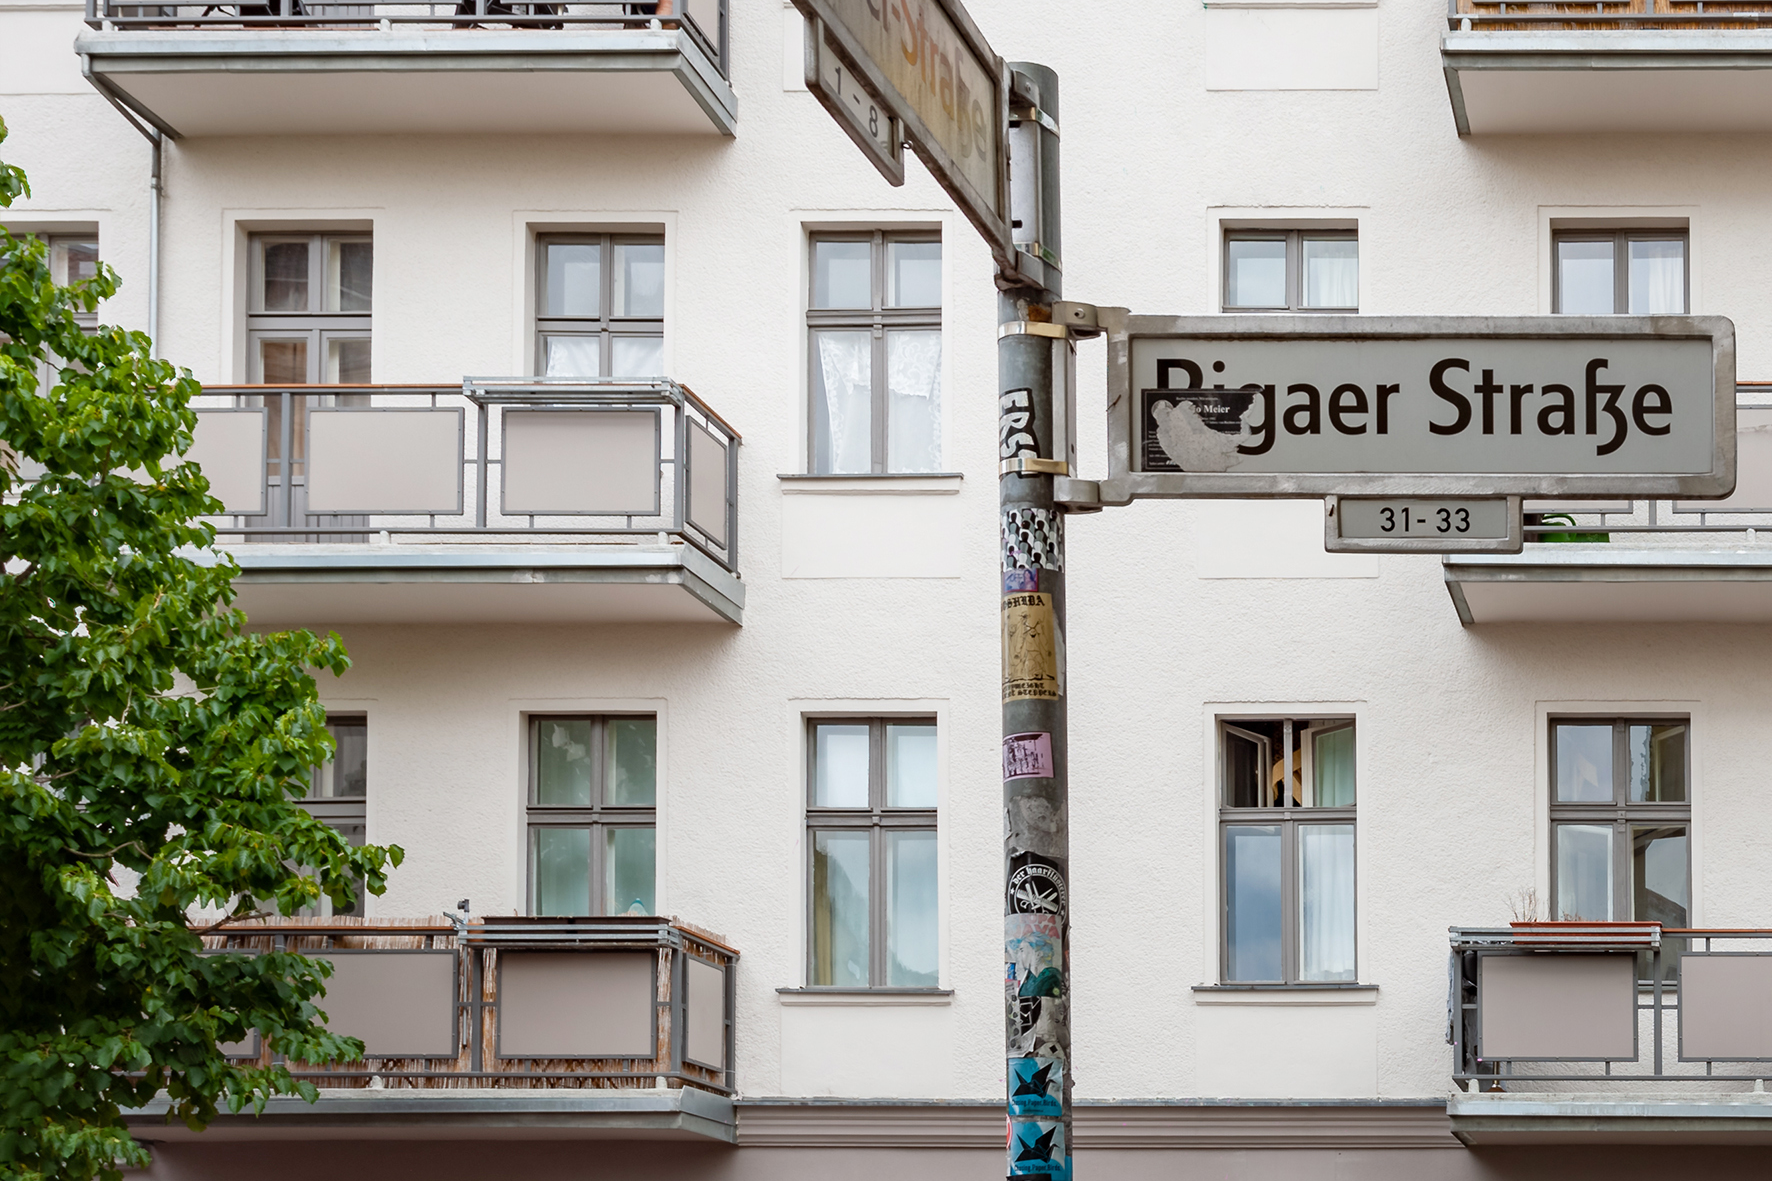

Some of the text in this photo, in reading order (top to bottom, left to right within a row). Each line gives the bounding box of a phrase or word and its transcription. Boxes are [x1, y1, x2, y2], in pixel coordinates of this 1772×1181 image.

[868, 104, 879, 138] 8
[1203, 404, 1231, 414] Meier
[1428, 357, 1673, 457] Straße
